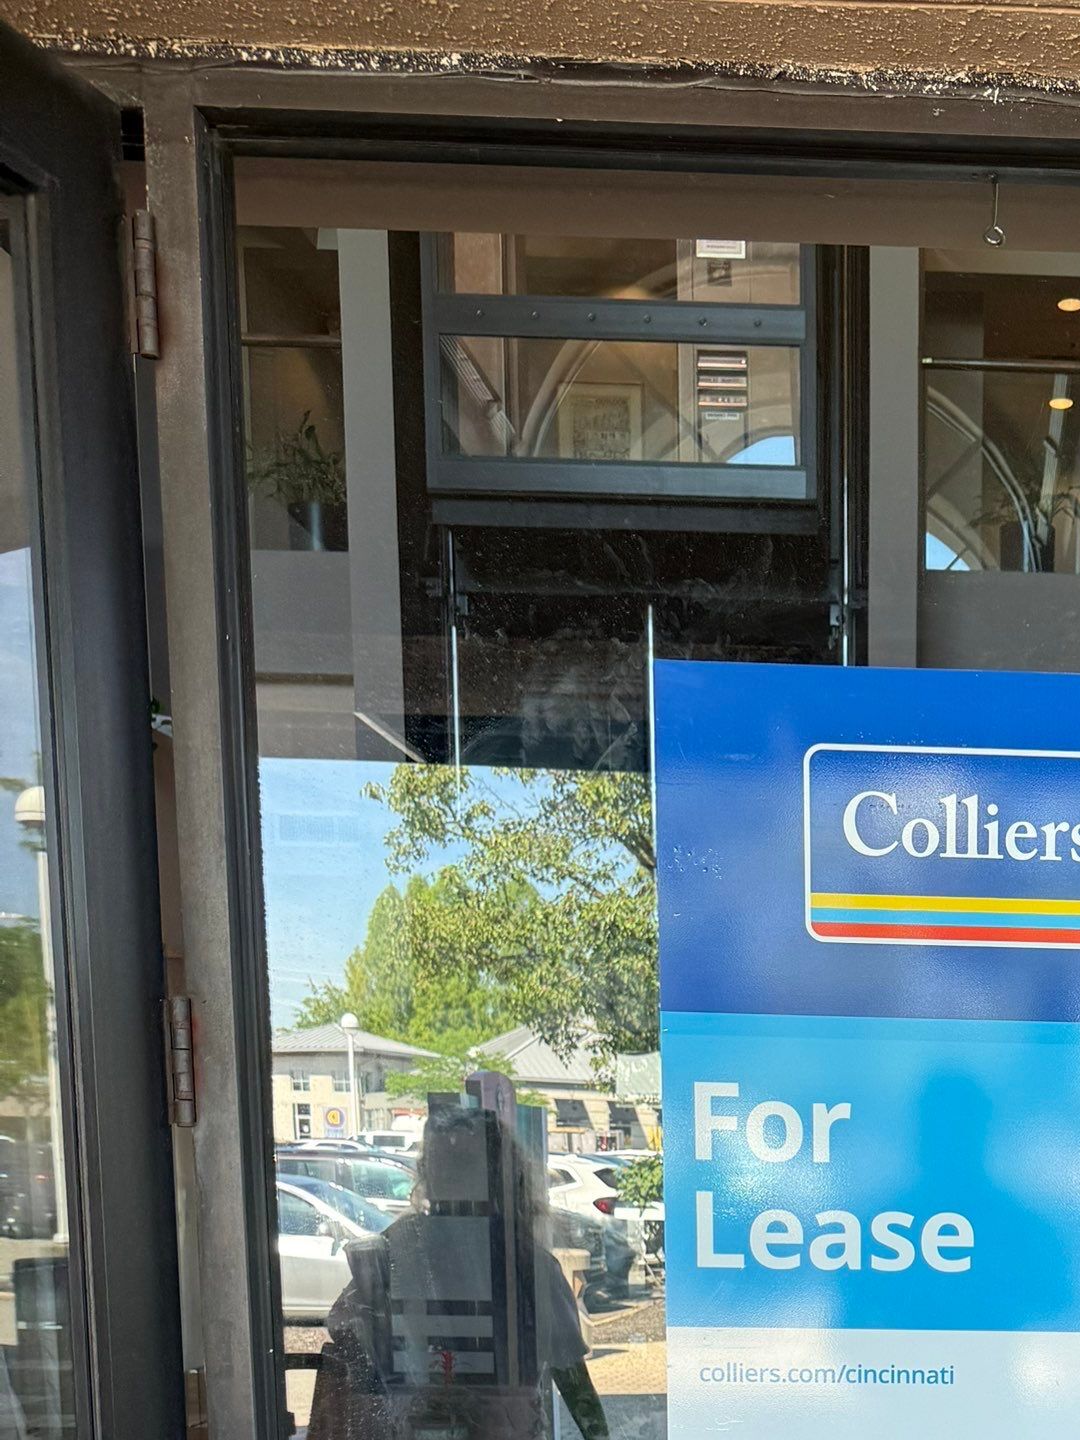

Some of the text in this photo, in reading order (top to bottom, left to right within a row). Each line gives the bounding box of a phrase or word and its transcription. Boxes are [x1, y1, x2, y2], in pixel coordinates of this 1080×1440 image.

[694, 1081, 851, 1163] For
[696, 1191, 975, 1272] Lease
[699, 1363, 954, 1386] colliers.com/cincinnati
